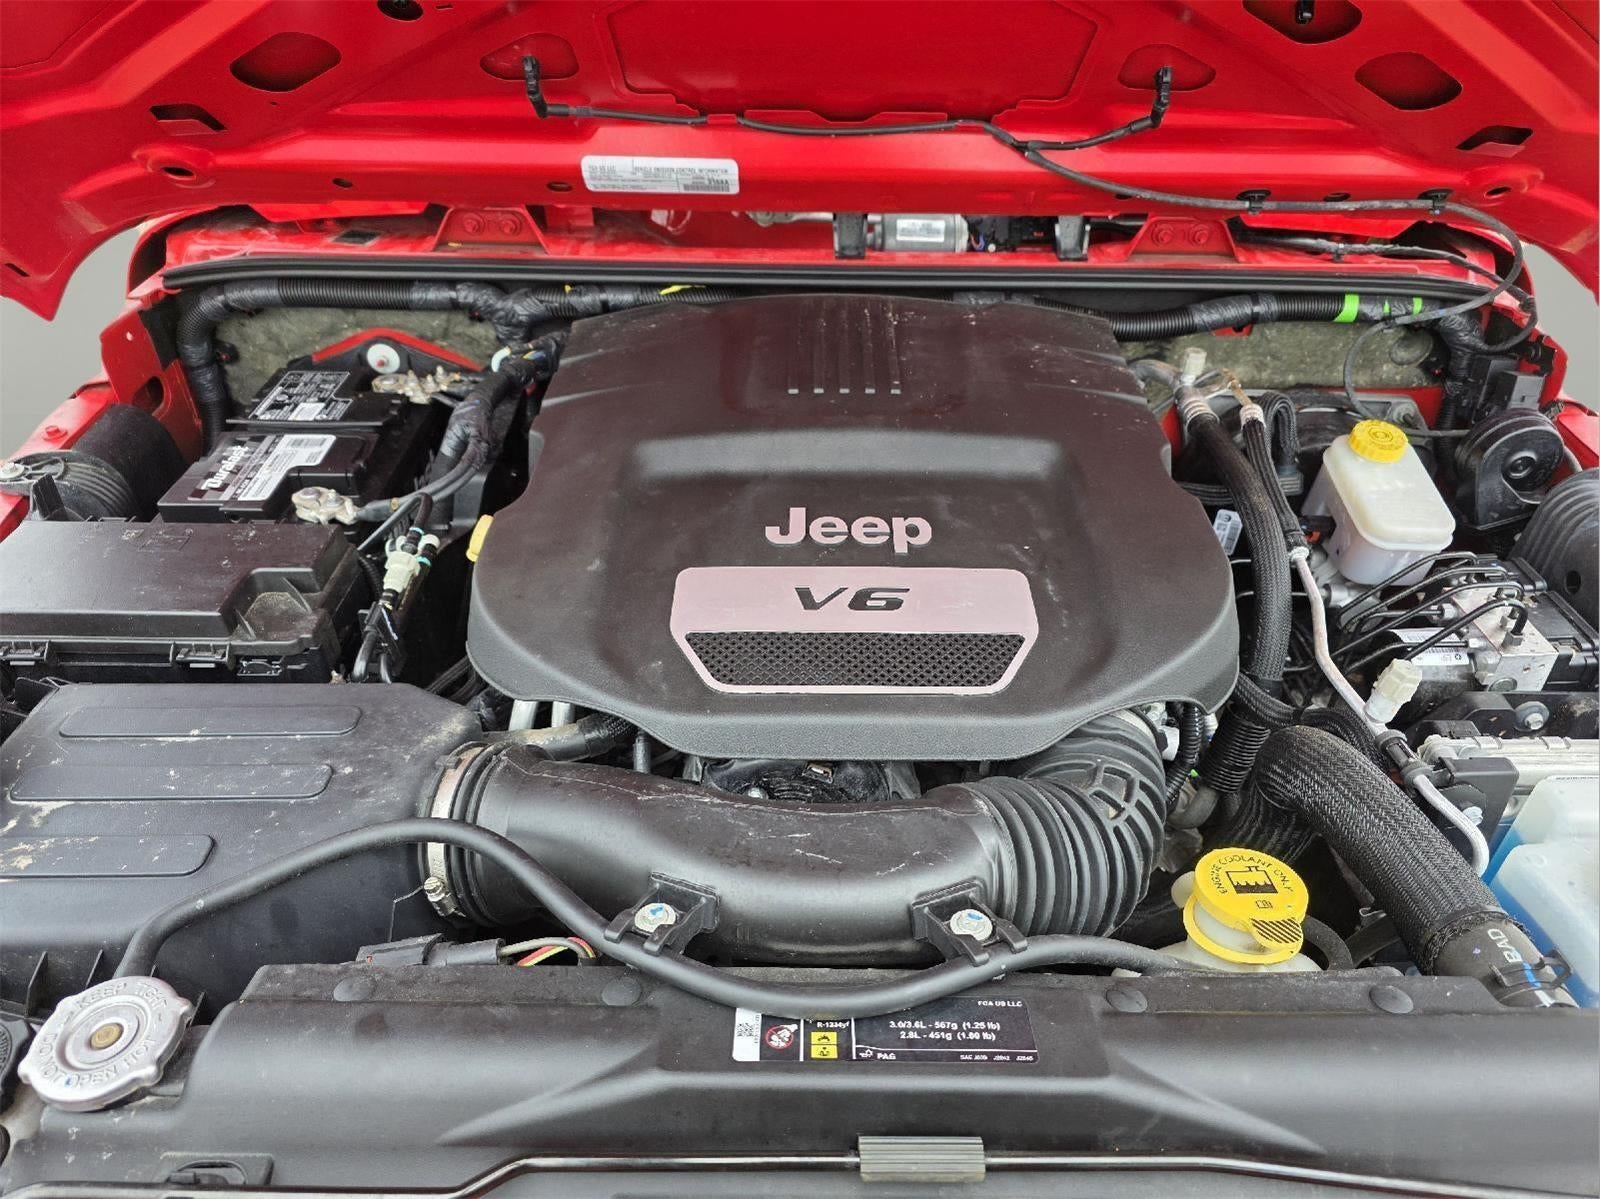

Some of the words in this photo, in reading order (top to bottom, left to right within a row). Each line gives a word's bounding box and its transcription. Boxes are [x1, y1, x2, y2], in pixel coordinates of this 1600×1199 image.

[200, 444, 250, 491] Duralast
[765, 507, 933, 554] Jeep
[794, 586, 911, 612] V6
[1218, 854, 1273, 869] COOLANT
[1273, 868, 1294, 893] ONLY
[1487, 927, 1523, 964] BAD
[76, 981, 128, 1009] KEEP
[816, 1021, 850, 1030] R-1234yf
[889, 1021, 927, 1029] 3.0/3.6L
[934, 1021, 959, 1031] 567g
[962, 1021, 986, 1031] (1.25
[987, 1022, 1001, 1031] lb)
[900, 1031, 922, 1039] 2.8L
[929, 1031, 953, 1041] 451g
[982, 1032, 997, 1041] lb)
[876, 1052, 897, 1060] PAG
